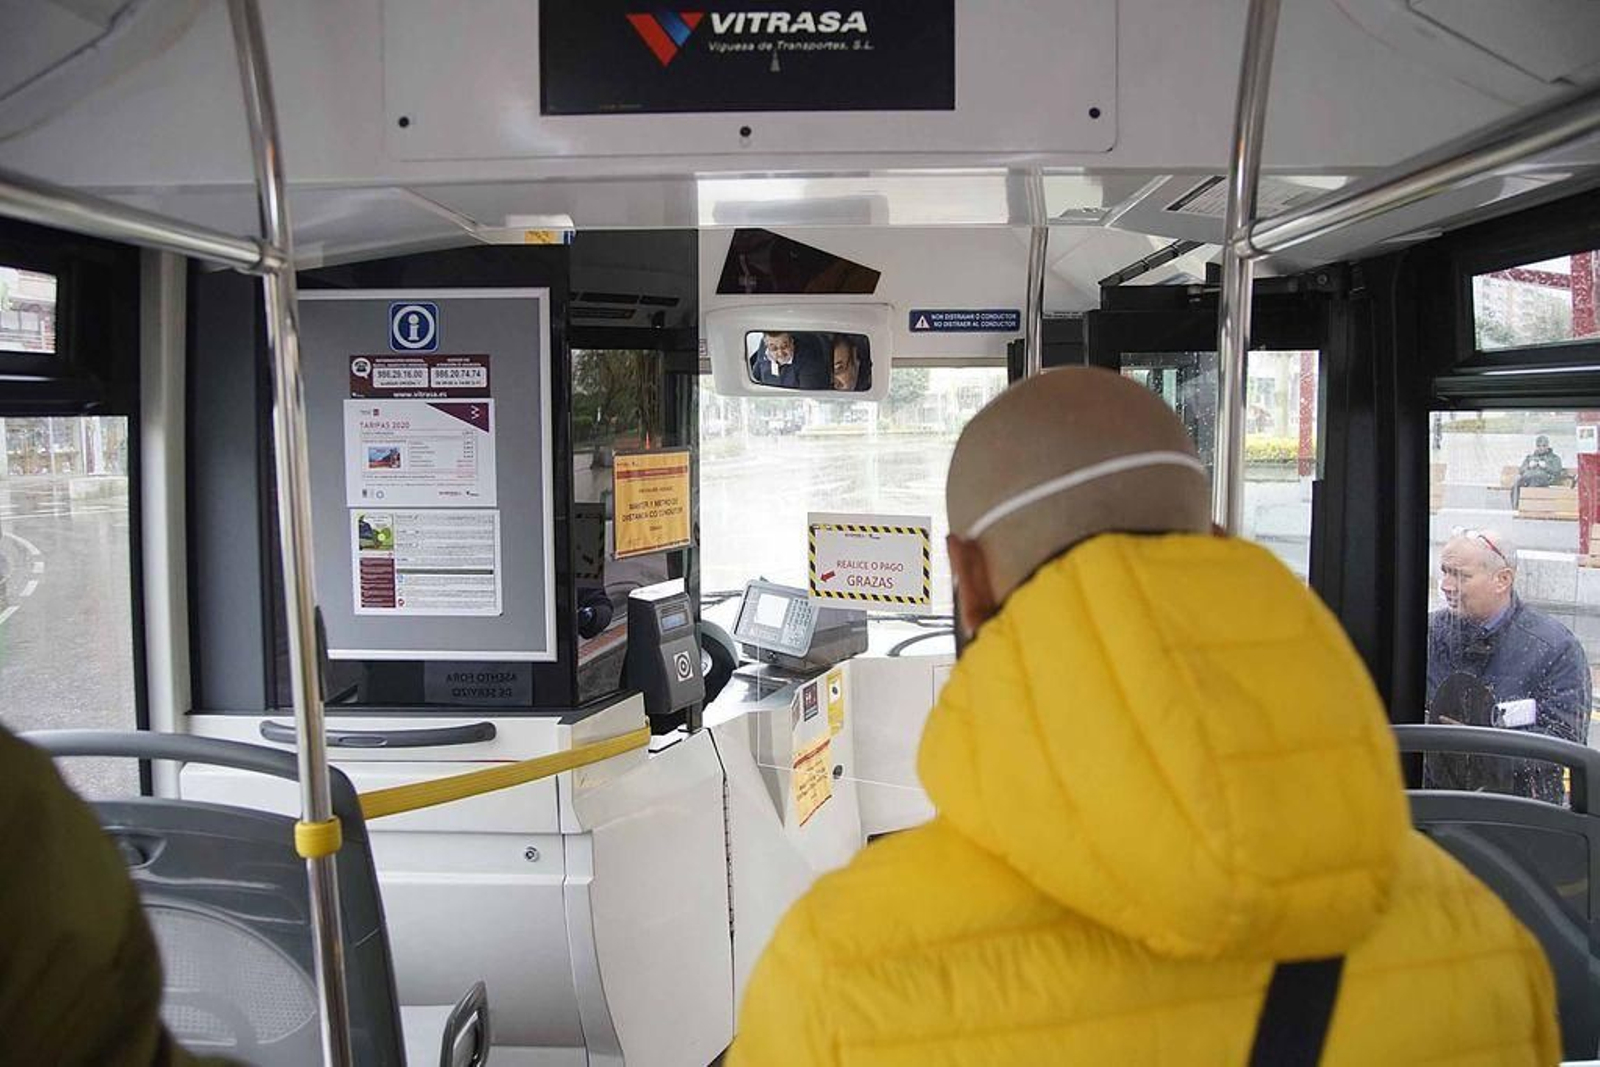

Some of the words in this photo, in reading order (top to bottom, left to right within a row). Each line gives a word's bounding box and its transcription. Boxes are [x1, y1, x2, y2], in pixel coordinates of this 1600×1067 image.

[711, 11, 868, 34] VITRASA
[708, 41, 755, 53] Viguesa
[757, 41, 773, 51] de
[852, 40, 875, 50] S.L.
[981, 313, 1017, 321] CONDUCTOR
[360, 421, 391, 429] TARIFAS
[392, 420, 411, 429] 2020
[836, 559, 868, 571] REALICE
[870, 561, 878, 571] O
[880, 562, 904, 572] PAGO
[846, 575, 894, 589] GRAZAS
